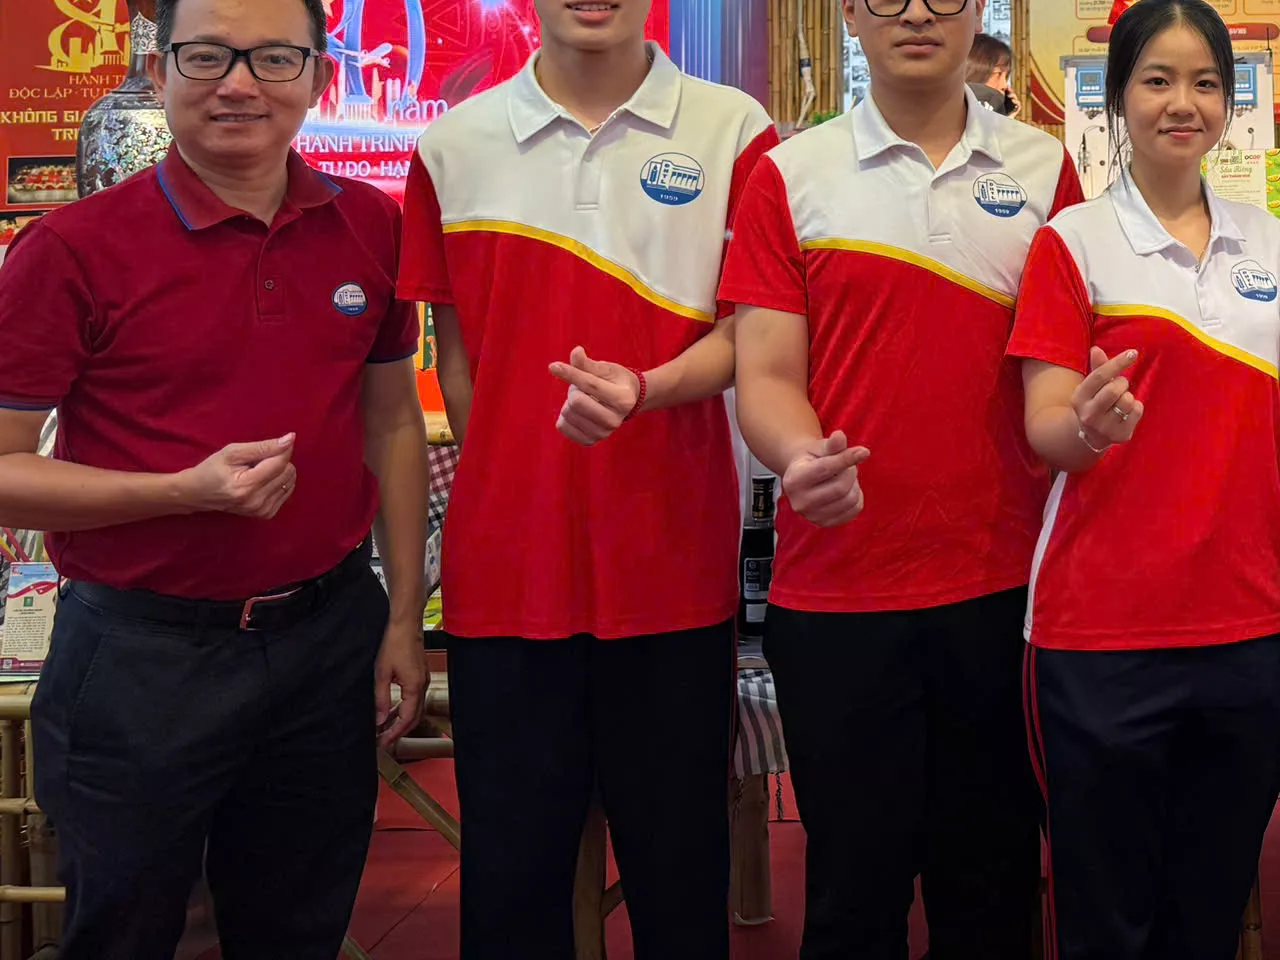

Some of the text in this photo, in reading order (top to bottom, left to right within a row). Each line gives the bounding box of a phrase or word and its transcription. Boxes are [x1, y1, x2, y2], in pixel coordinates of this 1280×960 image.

[69, 74, 109, 85] HÀNH
[9, 87, 41, 100] ĐỘC
[44, 86, 72, 100] LẬP
[347, 161, 371, 177] DO
